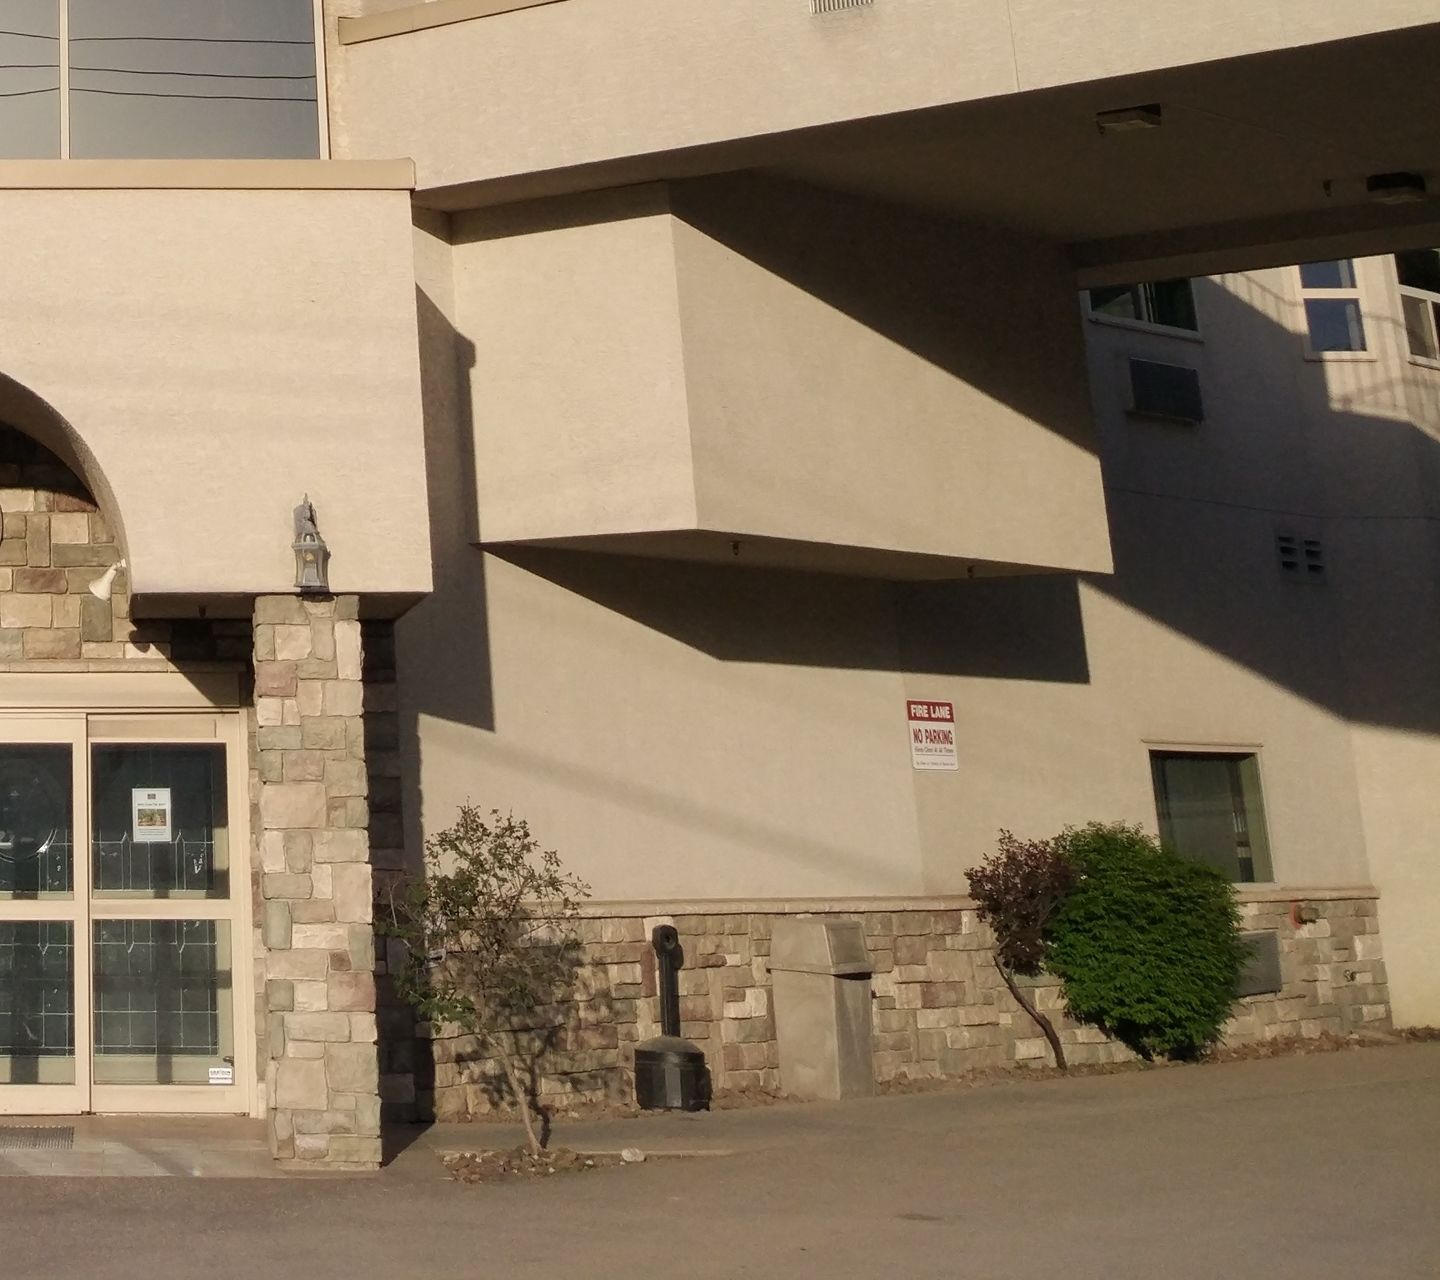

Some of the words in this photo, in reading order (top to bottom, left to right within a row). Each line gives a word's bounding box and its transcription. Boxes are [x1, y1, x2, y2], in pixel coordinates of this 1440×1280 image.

[910, 704, 929, 718] FIRE
[930, 705, 951, 719] LANE
[912, 728, 923, 744] NO
[924, 728, 953, 745] PARKING
